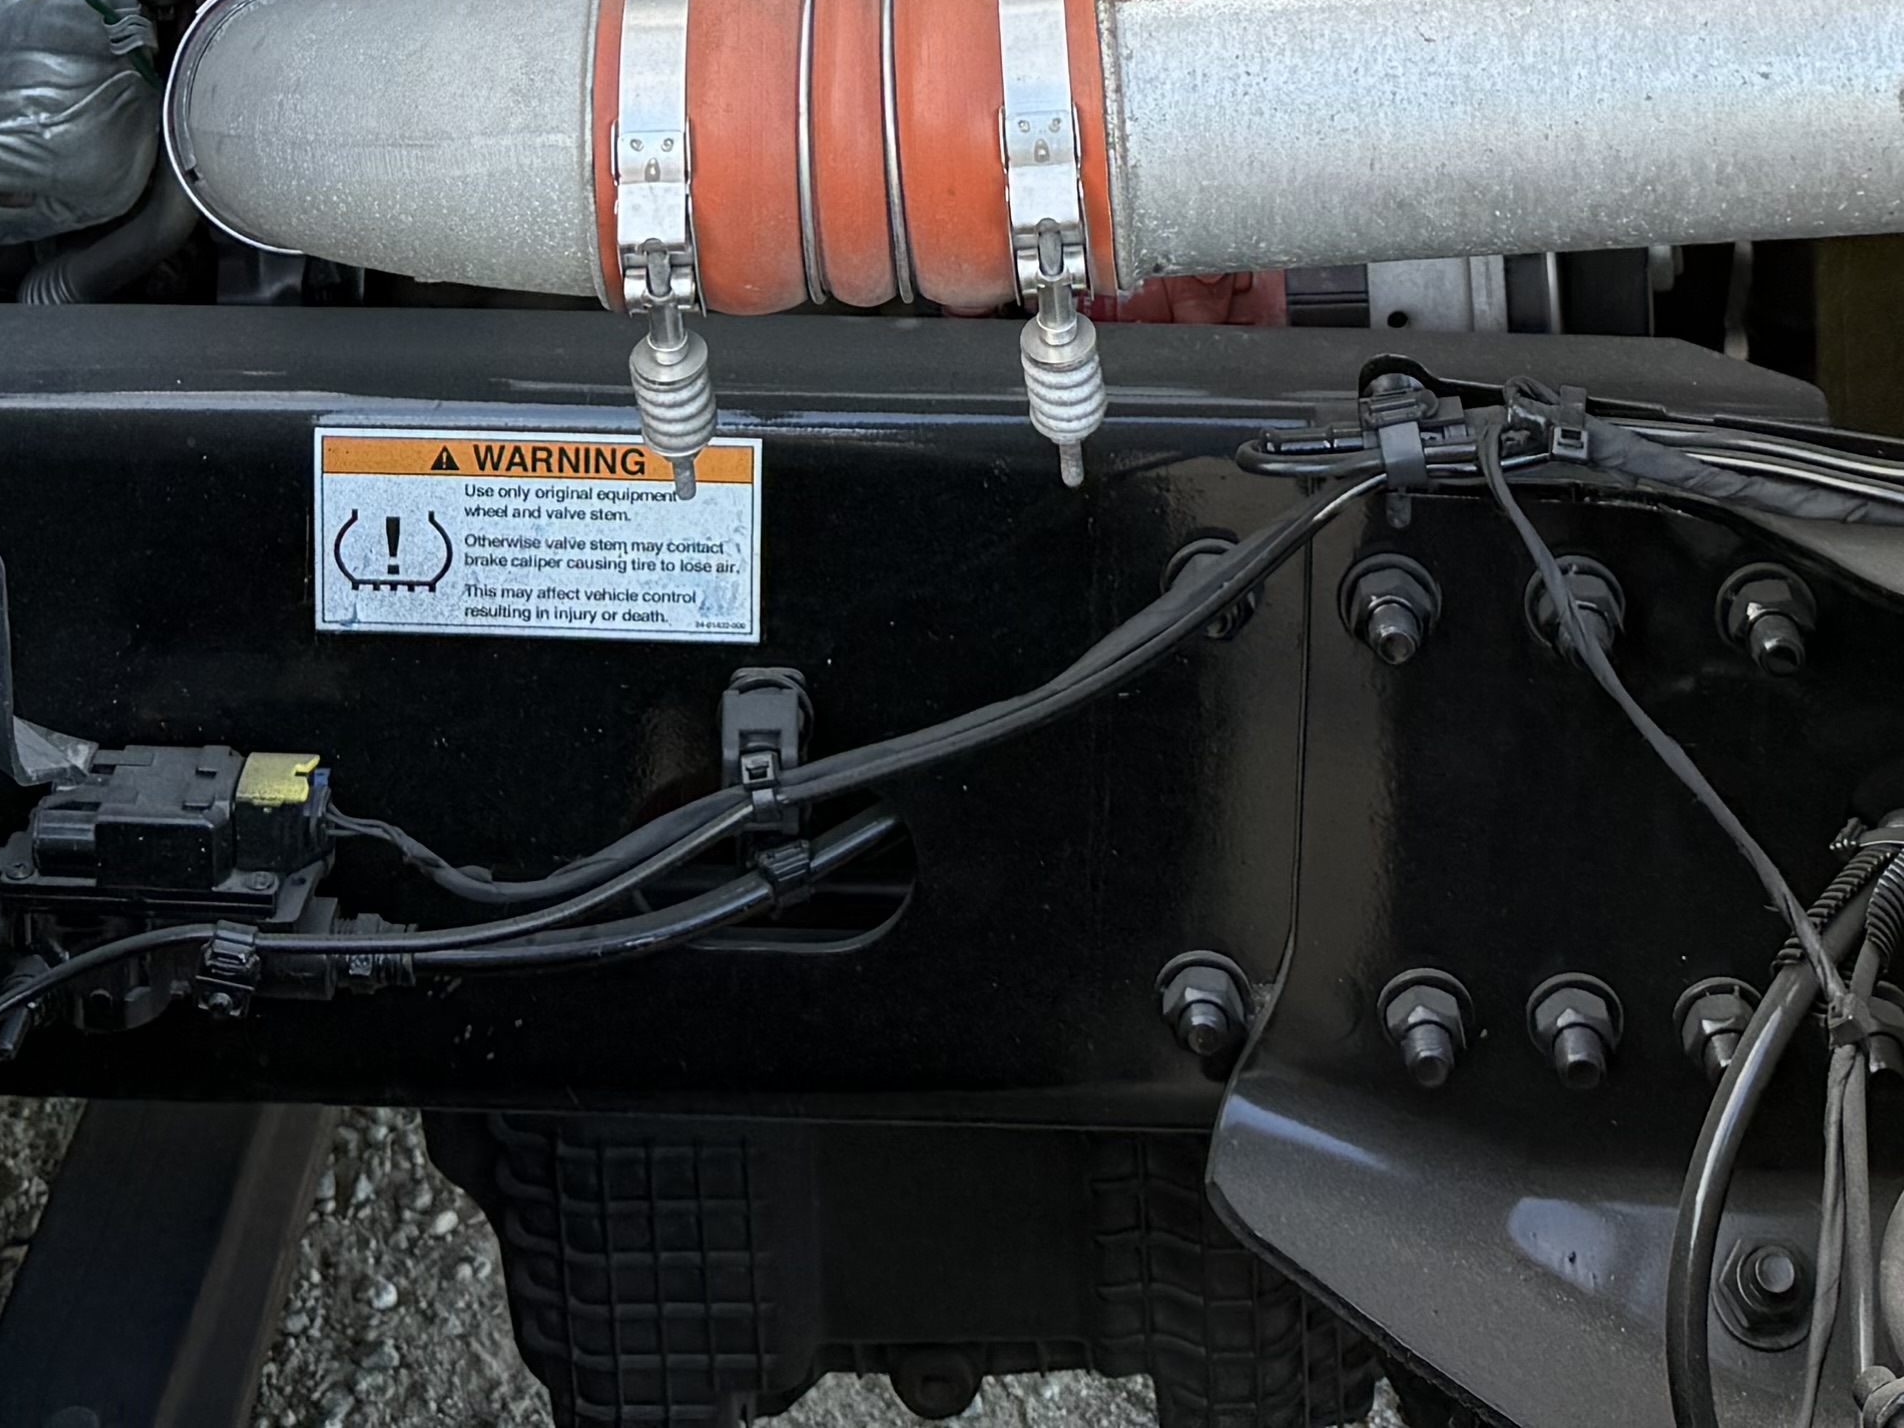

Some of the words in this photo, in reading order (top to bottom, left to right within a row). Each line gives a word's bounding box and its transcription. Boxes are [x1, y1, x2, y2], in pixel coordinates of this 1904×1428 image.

[473, 443, 647, 477] WARNING
[464, 483, 494, 498] Use
[497, 485, 531, 502] only
[535, 485, 593, 503] original
[596, 487, 678, 505] equipment
[464, 504, 508, 518] wheel
[512, 505, 542, 519] and
[546, 506, 587, 520] valve
[589, 507, 632, 521] stem.
[464, 533, 542, 549] Otherwise
[545, 536, 586, 550] valve
[589, 538, 628, 553] stem
[631, 541, 664, 555] may
[666, 541, 724, 554] contact
[464, 552, 508, 567] brake
[511, 554, 563, 571] caliper
[566, 556, 627, 574] causing
[631, 557, 657, 571] tire
[660, 559, 676, 572] to
[680, 559, 713, 573] lose
[715, 560, 741, 574] air.
[465, 583, 497, 598] This
[501, 587, 533, 602] may
[537, 586, 581, 601] affect
[584, 587, 638, 602] vehicle
[642, 589, 697, 604] control
[464, 604, 532, 622] resulting
[536, 606, 550, 620] in
[554, 606, 597, 624] injury
[601, 610, 618, 621] or
[622, 608, 669, 623] death.
